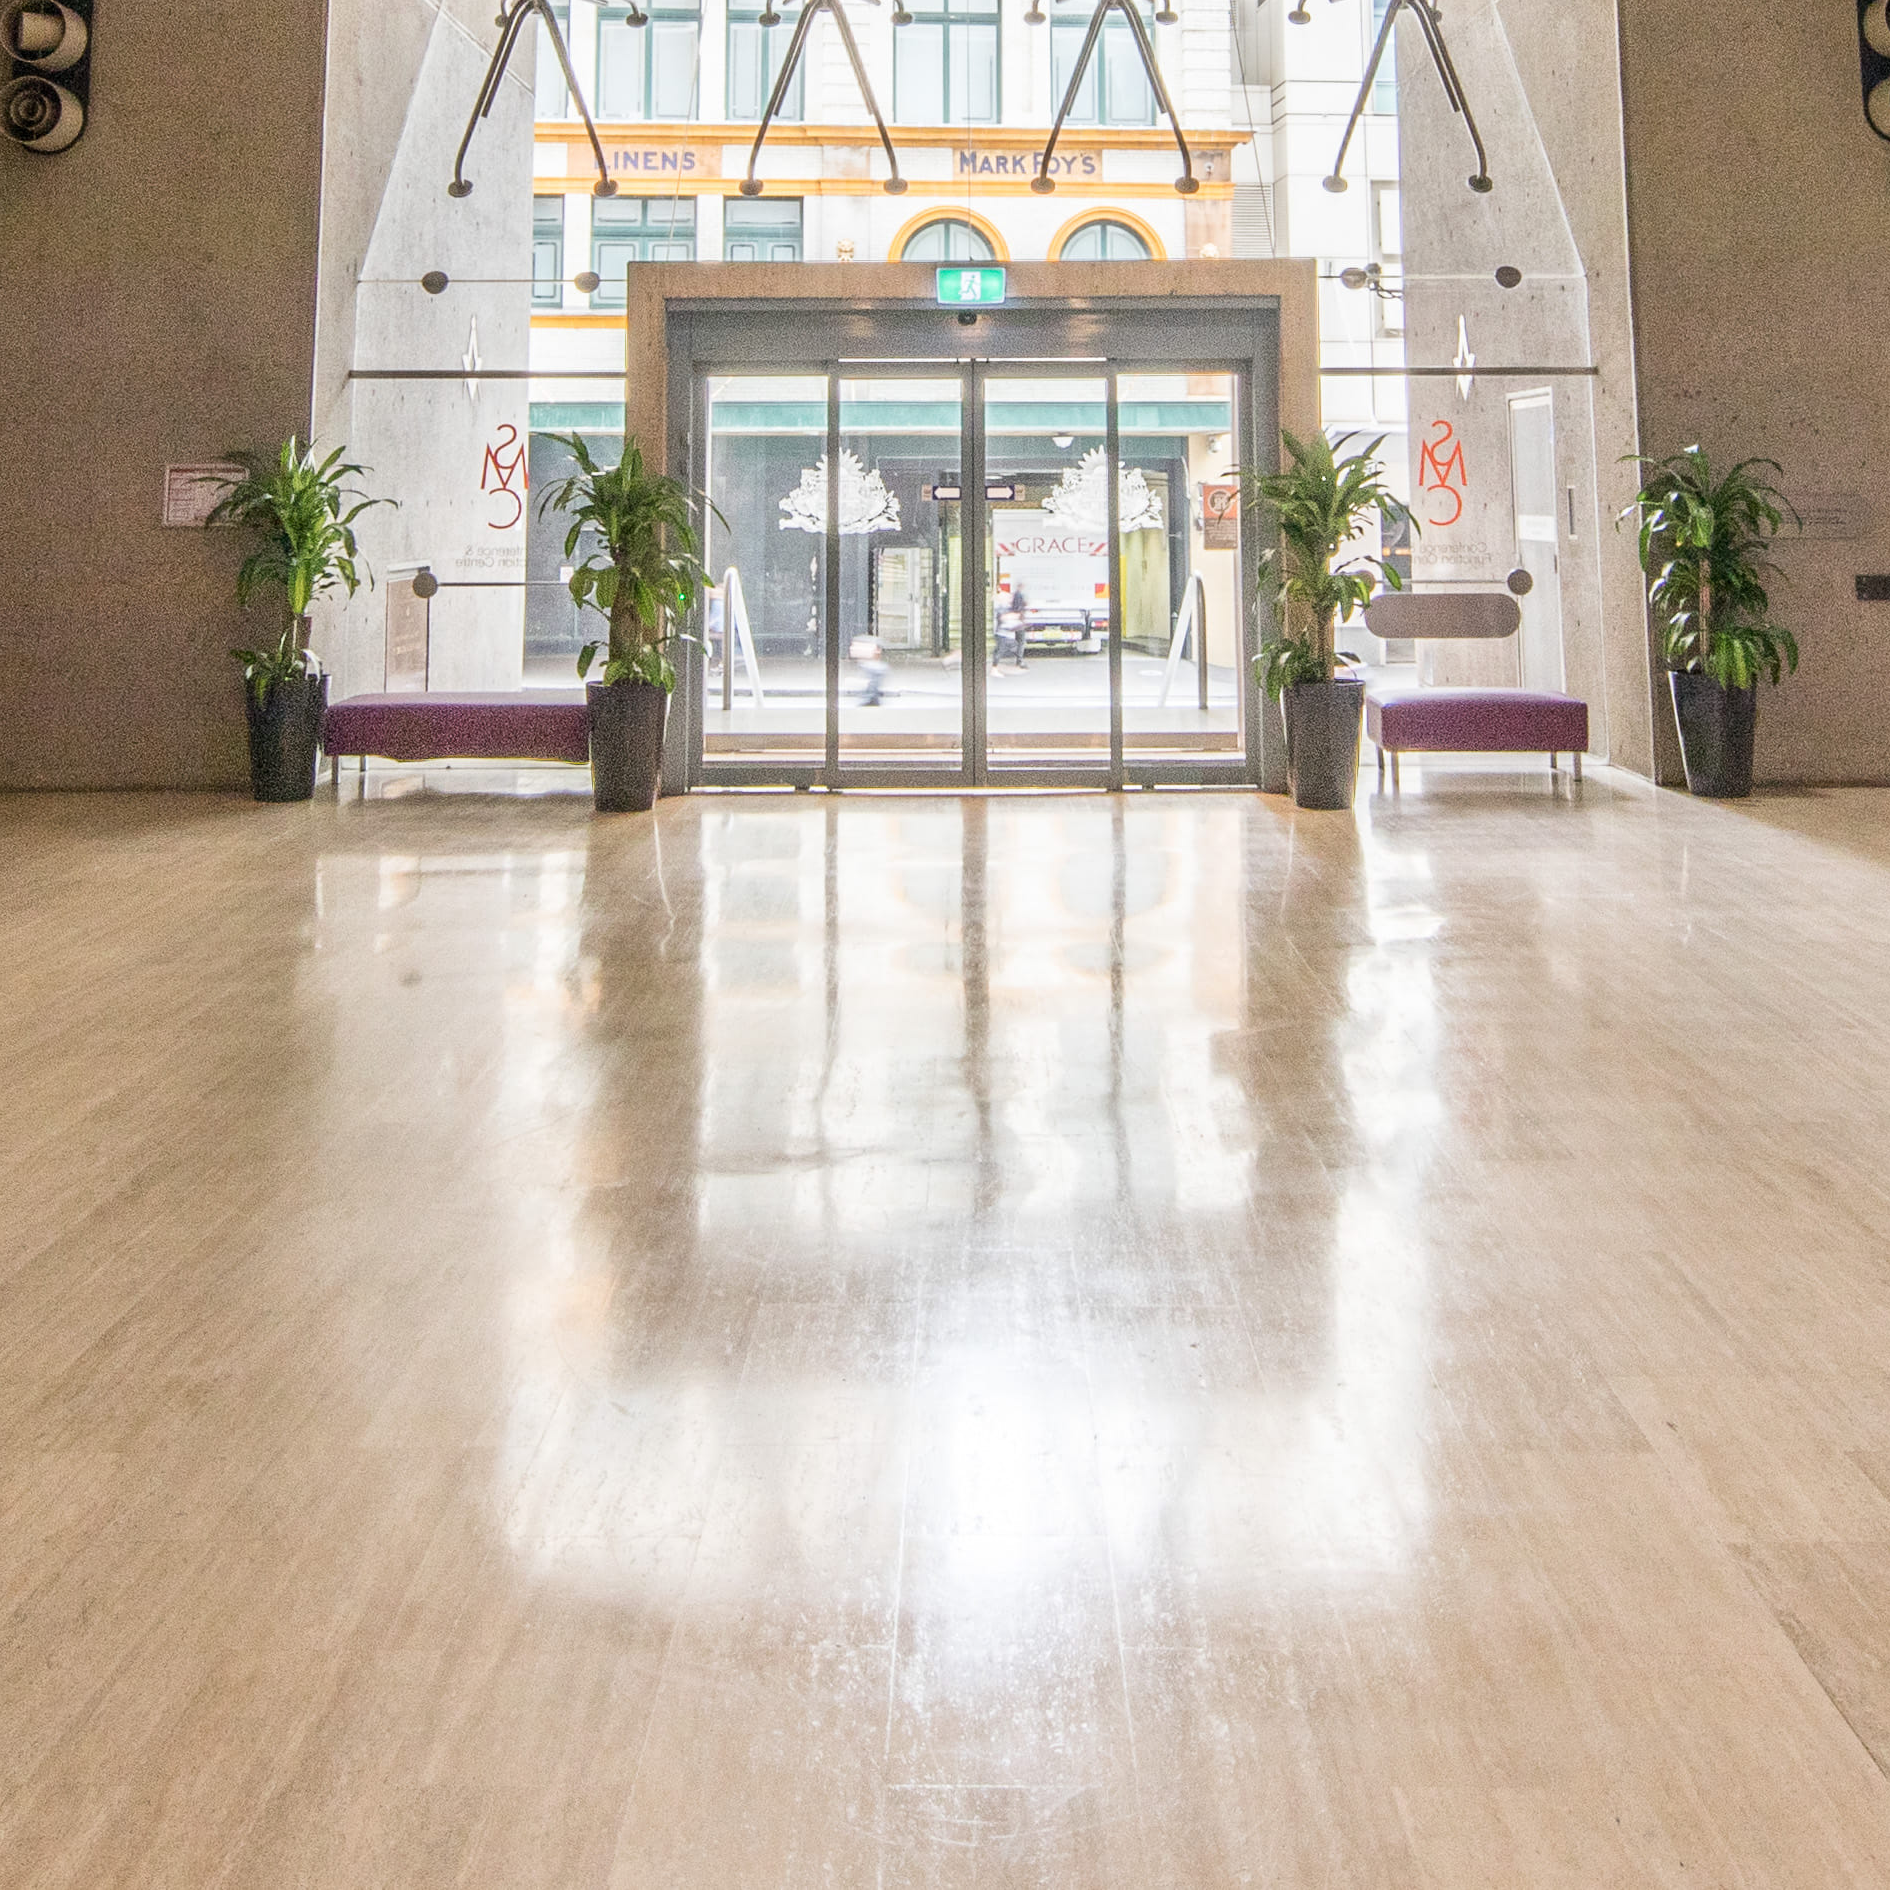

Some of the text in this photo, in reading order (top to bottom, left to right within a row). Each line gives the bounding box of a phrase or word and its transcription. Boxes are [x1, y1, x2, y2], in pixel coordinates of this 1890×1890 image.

[959, 150, 1096, 174] MARK FOY'S
[1015, 537, 1088, 553] GRACE
